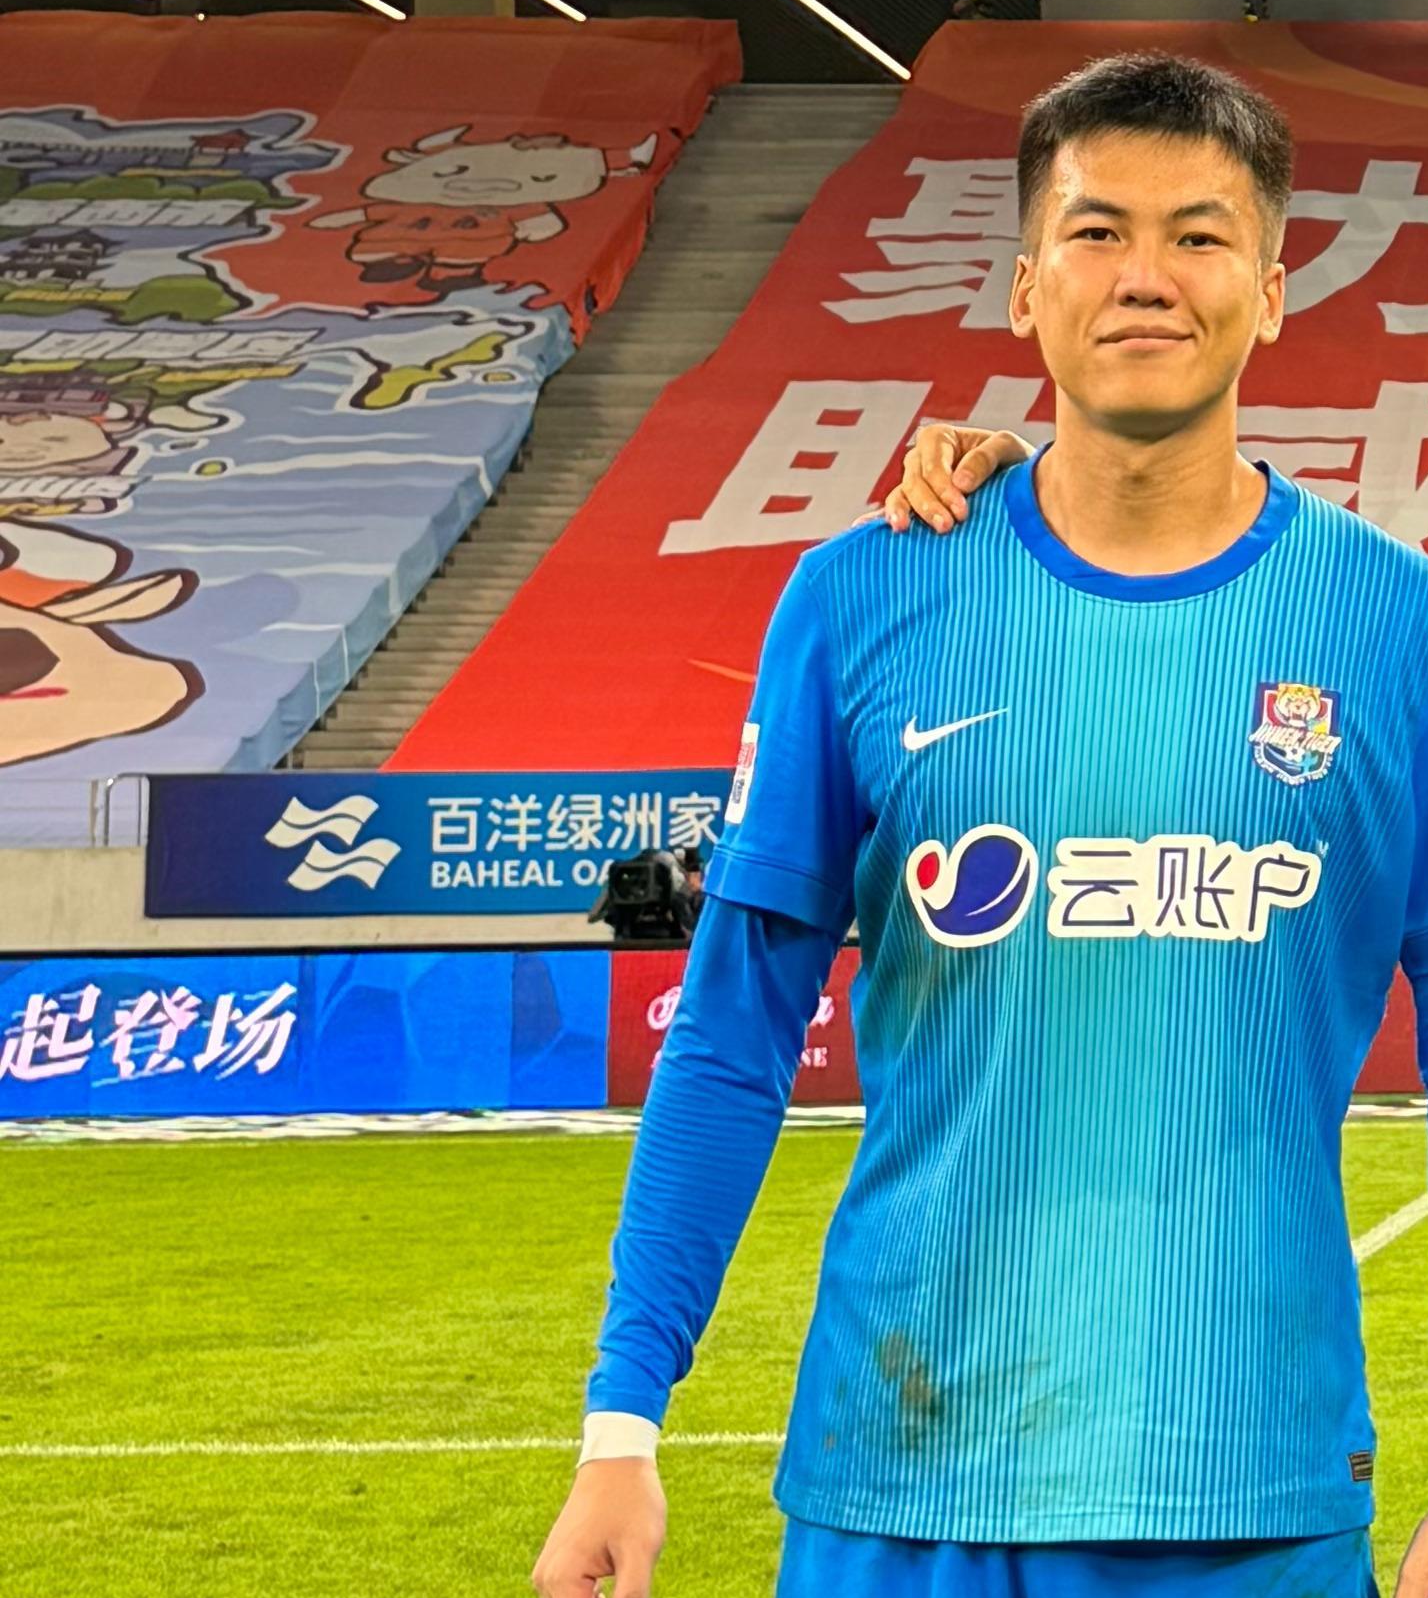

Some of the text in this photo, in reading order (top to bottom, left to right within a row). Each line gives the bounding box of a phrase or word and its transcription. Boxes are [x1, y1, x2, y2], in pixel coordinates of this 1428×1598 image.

[428, 792, 722, 853] 百洋绿洲家
[430, 859, 563, 888] BAHEAL
[1060, 844, 1312, 933] 云账户
[0, 982, 298, 1087] 起登场
